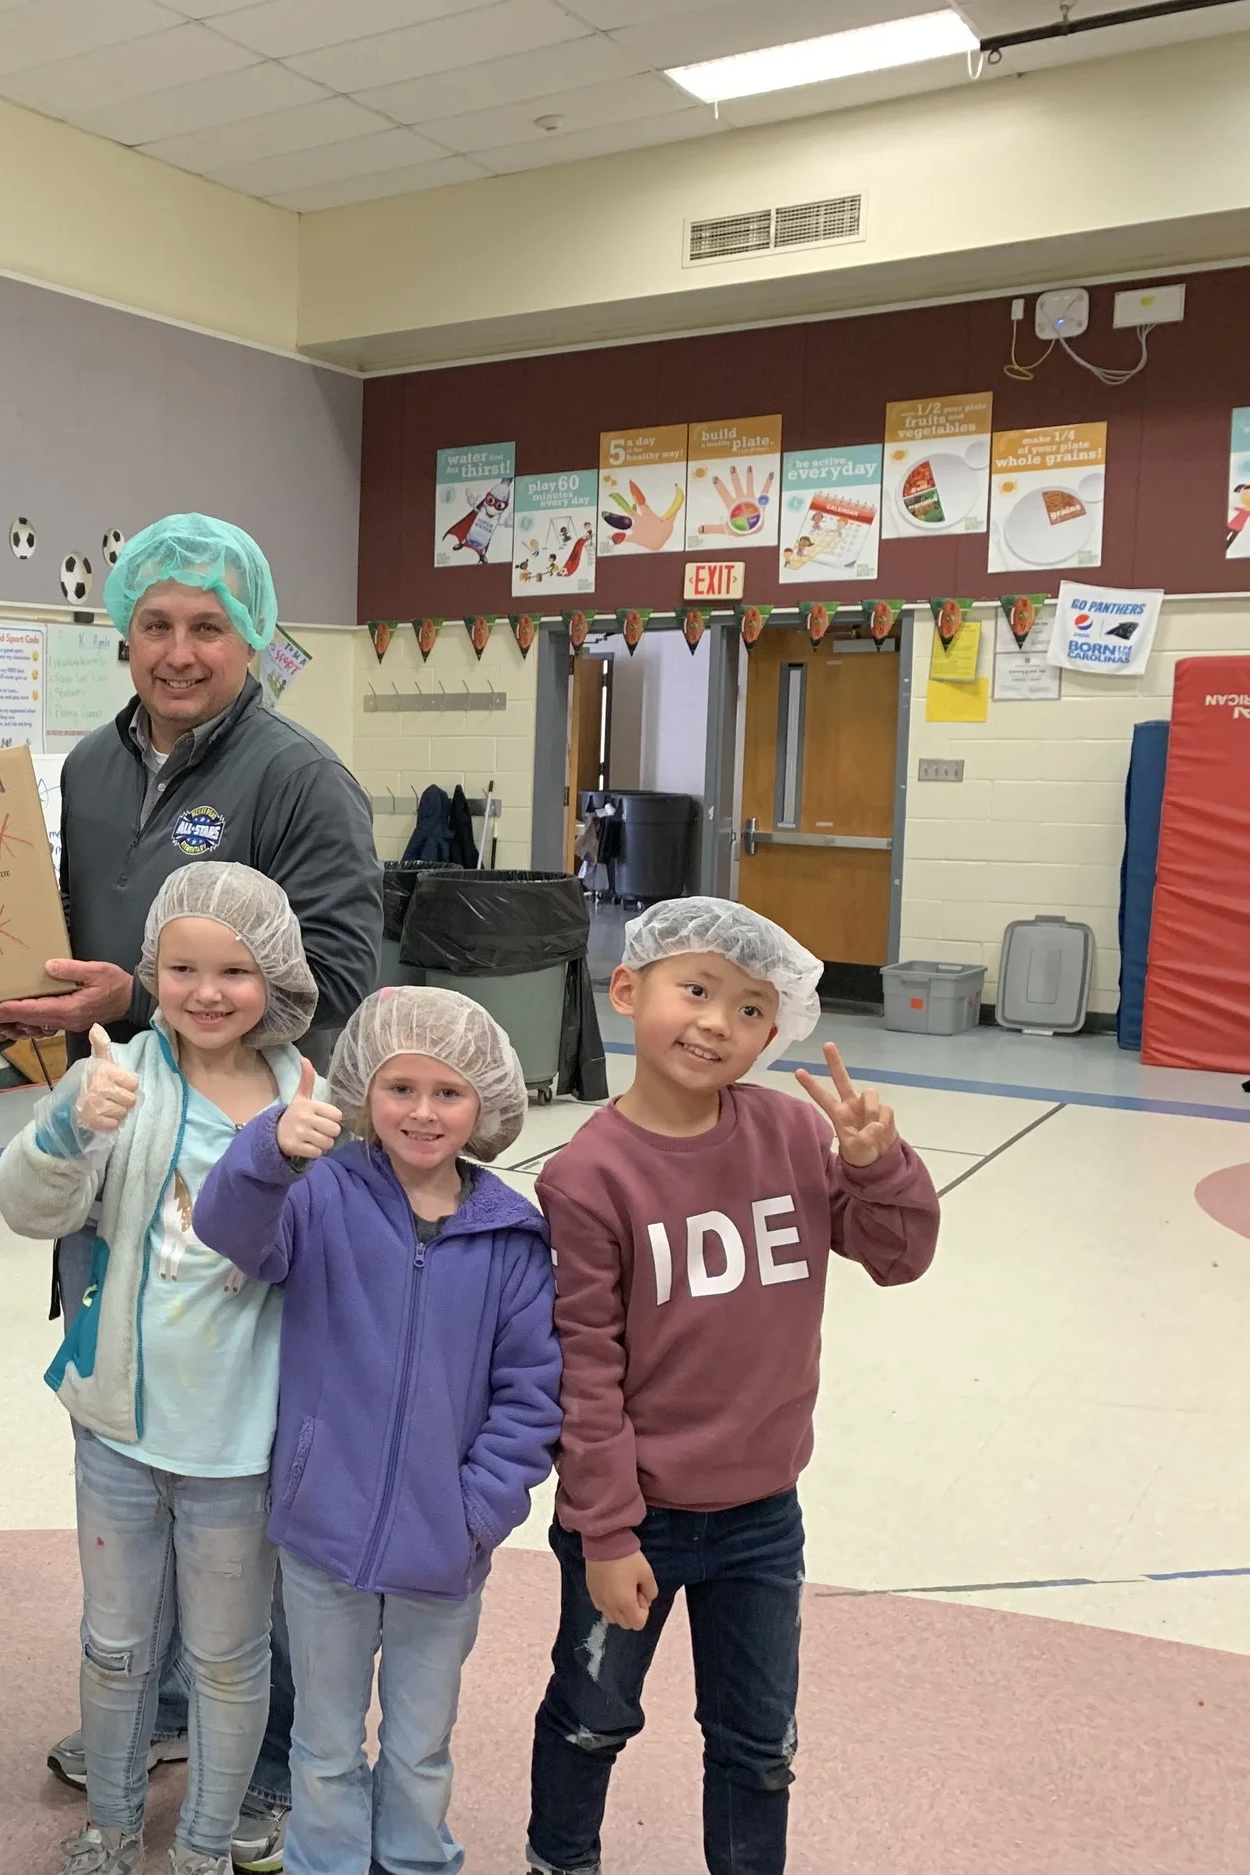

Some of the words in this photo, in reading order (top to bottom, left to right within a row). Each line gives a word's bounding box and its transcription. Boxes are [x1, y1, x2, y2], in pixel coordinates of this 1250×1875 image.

[917, 402, 942, 416] 1/2
[905, 415, 946, 427] fruits
[701, 427, 737, 441] build
[897, 422, 976, 440] vegetables
[1022, 435, 1051, 444] make
[1054, 429, 1075, 441] 1/4
[609, 438, 626, 466] 5
[636, 436, 656, 448] day
[626, 451, 660, 461] healthy
[662, 448, 683, 458] way!
[1017, 446, 1029, 455] of
[1032, 444, 1057, 455] your
[1060, 441, 1090, 452] plate
[447, 452, 488, 465] water
[795, 460, 809, 469] be
[812, 456, 847, 467] active
[995, 454, 1041, 467] whole
[1045, 447, 1102, 466] grains!
[461, 460, 511, 478] thirst!
[787, 460, 878, 481] everyday
[528, 480, 556, 495] play
[558, 474, 579, 491] 60
[533, 491, 574, 501] minutes
[540, 499, 569, 508] every
[572, 495, 590, 505] day
[1050, 504, 1081, 520] grains
[694, 565, 735, 595] EXIT
[1070, 598, 1088, 611] GO
[1088, 601, 1147, 615] PANTHERS
[6, 633, 24, 645] Sport
[25, 635, 39, 644] Code
[1068, 640, 1117, 656] BORN
[1067, 651, 1131, 664] CAROLINAS
[647, 1194, 810, 1306] IDE
